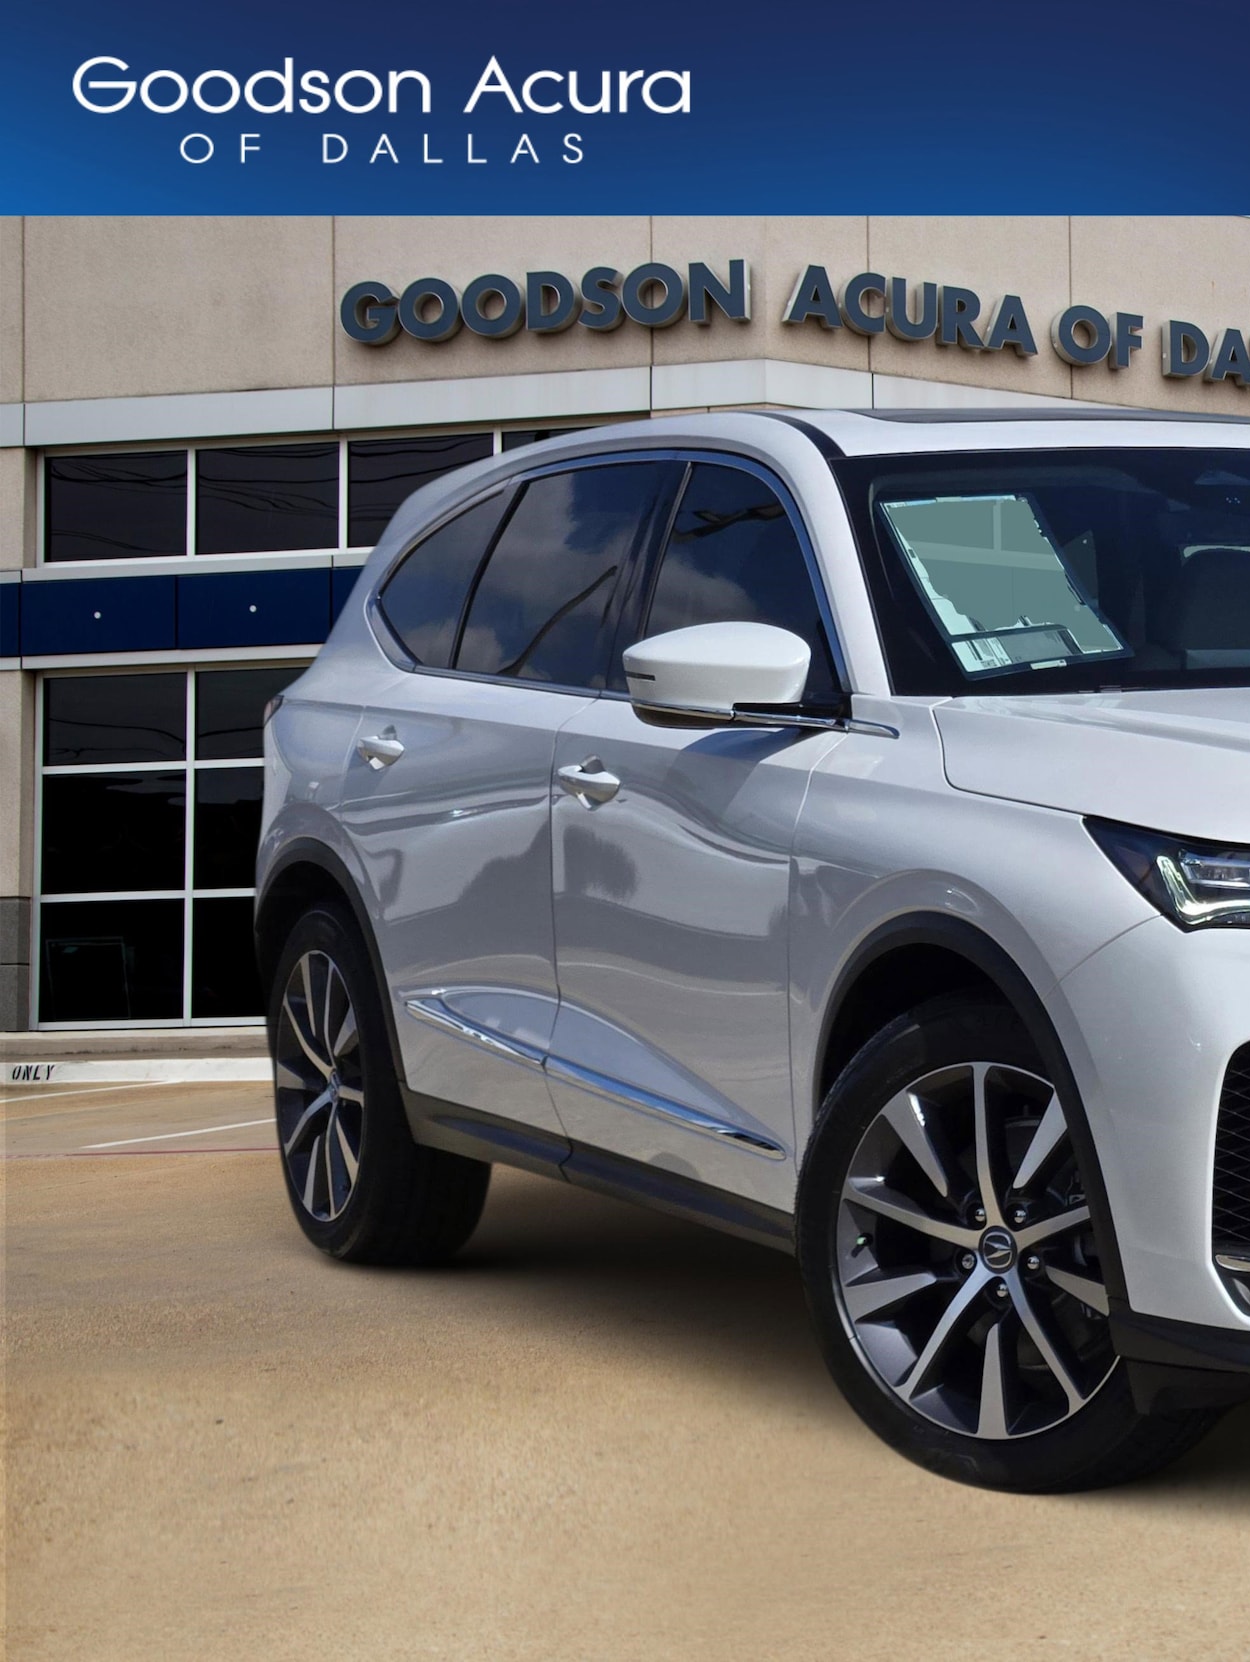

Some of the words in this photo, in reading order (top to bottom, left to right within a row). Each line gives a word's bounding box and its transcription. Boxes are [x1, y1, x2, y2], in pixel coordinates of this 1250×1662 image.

[340, 259, 751, 346] GOODSON
[782, 264, 1038, 357] ACURA
[1051, 304, 1144, 370] OF
[12, 1064, 55, 1081] ONLY
